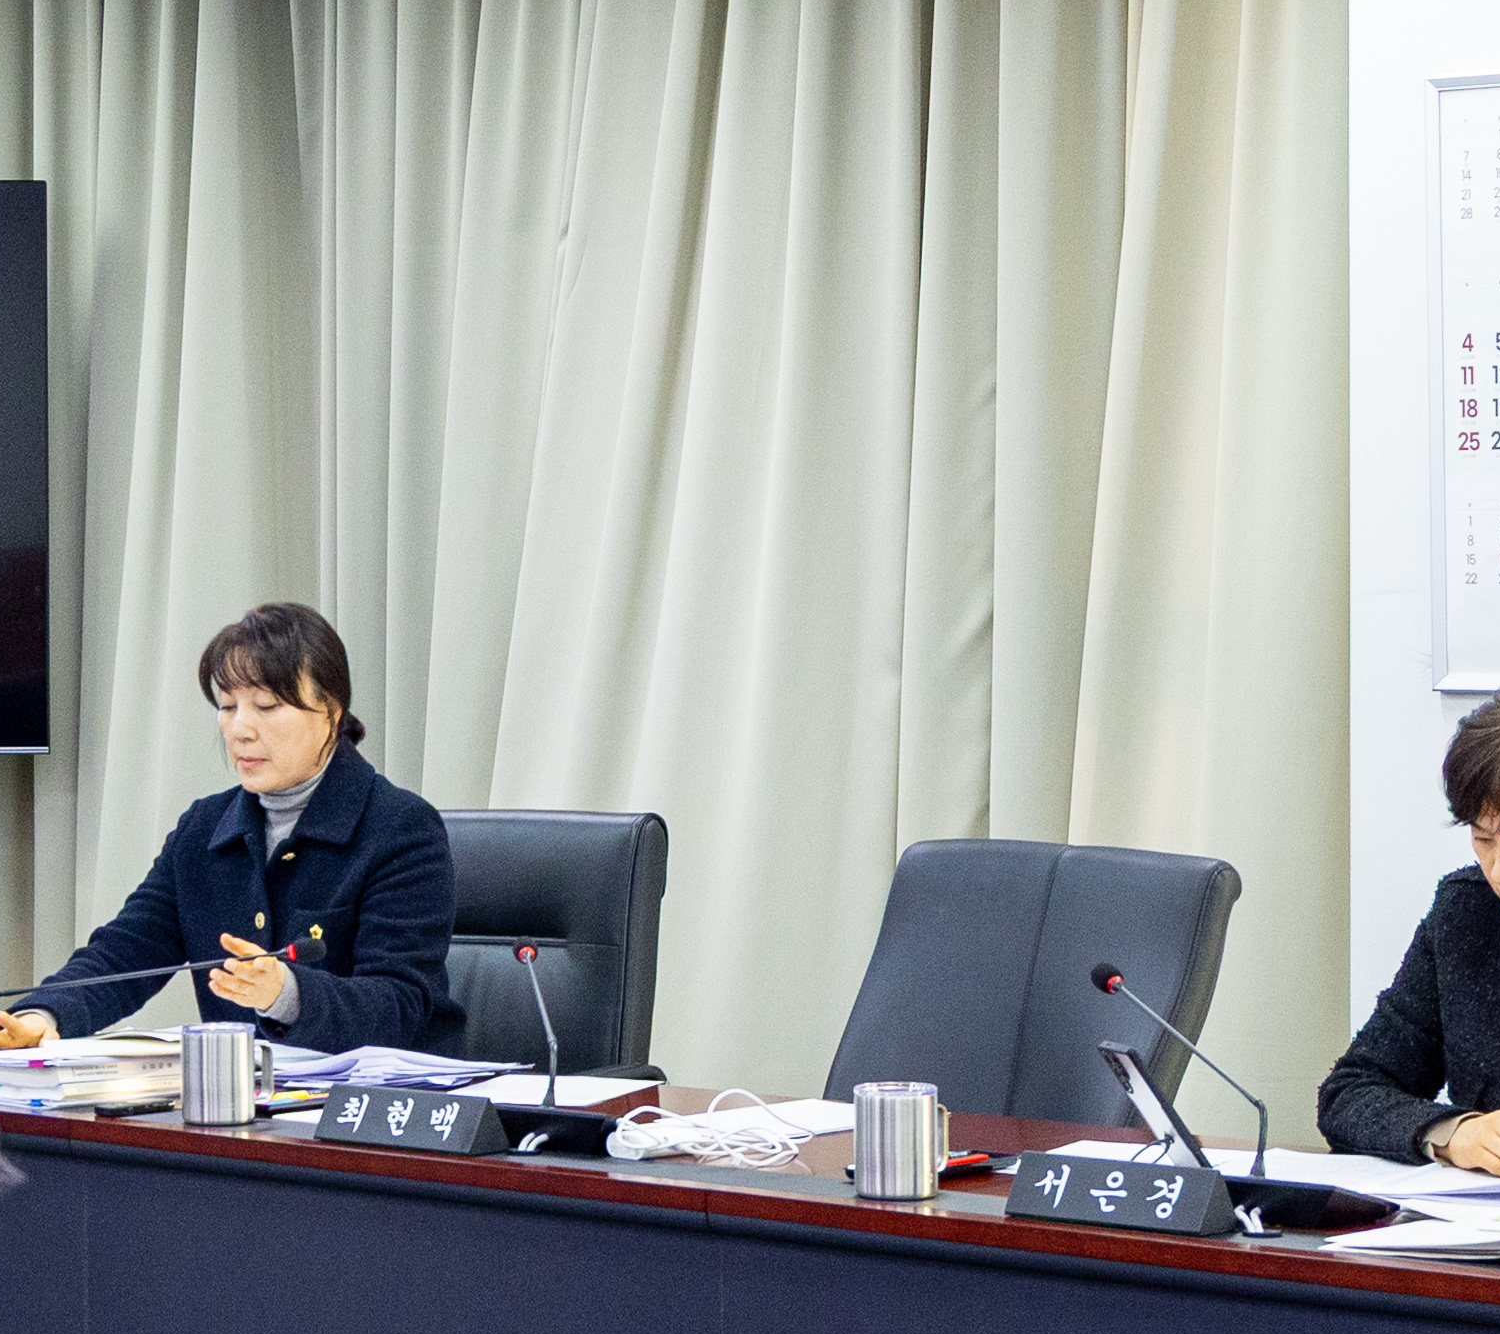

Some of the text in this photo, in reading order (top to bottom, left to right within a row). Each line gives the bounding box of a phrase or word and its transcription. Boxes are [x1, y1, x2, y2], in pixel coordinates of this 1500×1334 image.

[1463, 151, 1470, 161] 7
[1462, 170, 1471, 180] 14
[1462, 189, 1470, 200] 21
[1461, 208, 1472, 219] 28
[1463, 334, 1473, 351] 4
[1461, 366, 1474, 384] 11
[1460, 399, 1478, 417] 18
[1459, 432, 1480, 450] 25
[1468, 516, 1473, 526] 1
[1467, 535, 1475, 546] 8
[1466, 554, 1476, 565] 15
[1465, 573, 1477, 584] 22
